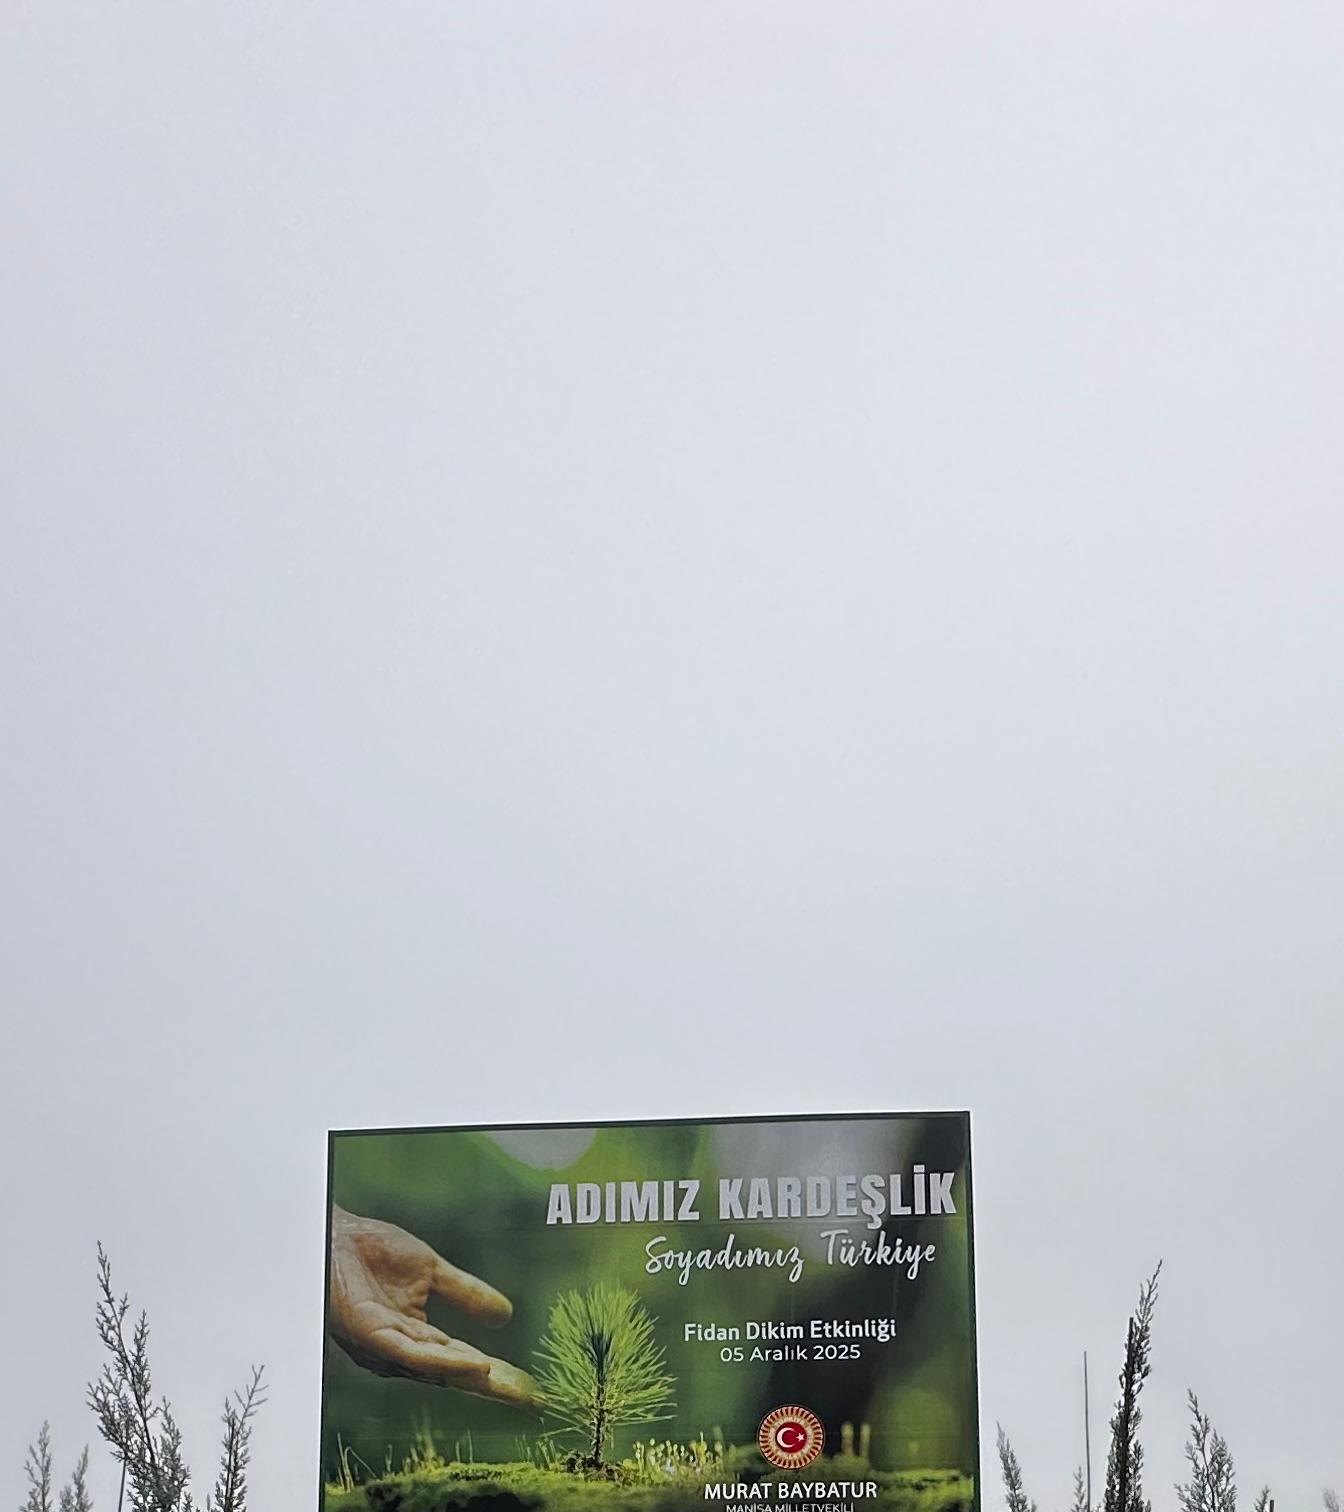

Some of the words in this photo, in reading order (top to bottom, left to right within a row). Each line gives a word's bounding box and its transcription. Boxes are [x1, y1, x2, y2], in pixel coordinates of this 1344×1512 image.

[546, 1179, 700, 1225] ADIMIZ
[719, 1164, 957, 1230] KARDEŞLİK
[645, 1233, 806, 1286] Soyadımız
[820, 1229, 936, 1280] Türkiye
[684, 1323, 740, 1341] Fidan
[746, 1321, 804, 1340] Dikim
[810, 1318, 897, 1342] Etkinliği
[720, 1347, 744, 1362] 05
[749, 1345, 807, 1361] Aralık
[813, 1344, 861, 1360] 2025
[704, 1483, 773, 1500] MURAT
[778, 1481, 877, 1499] BAYBATUR
